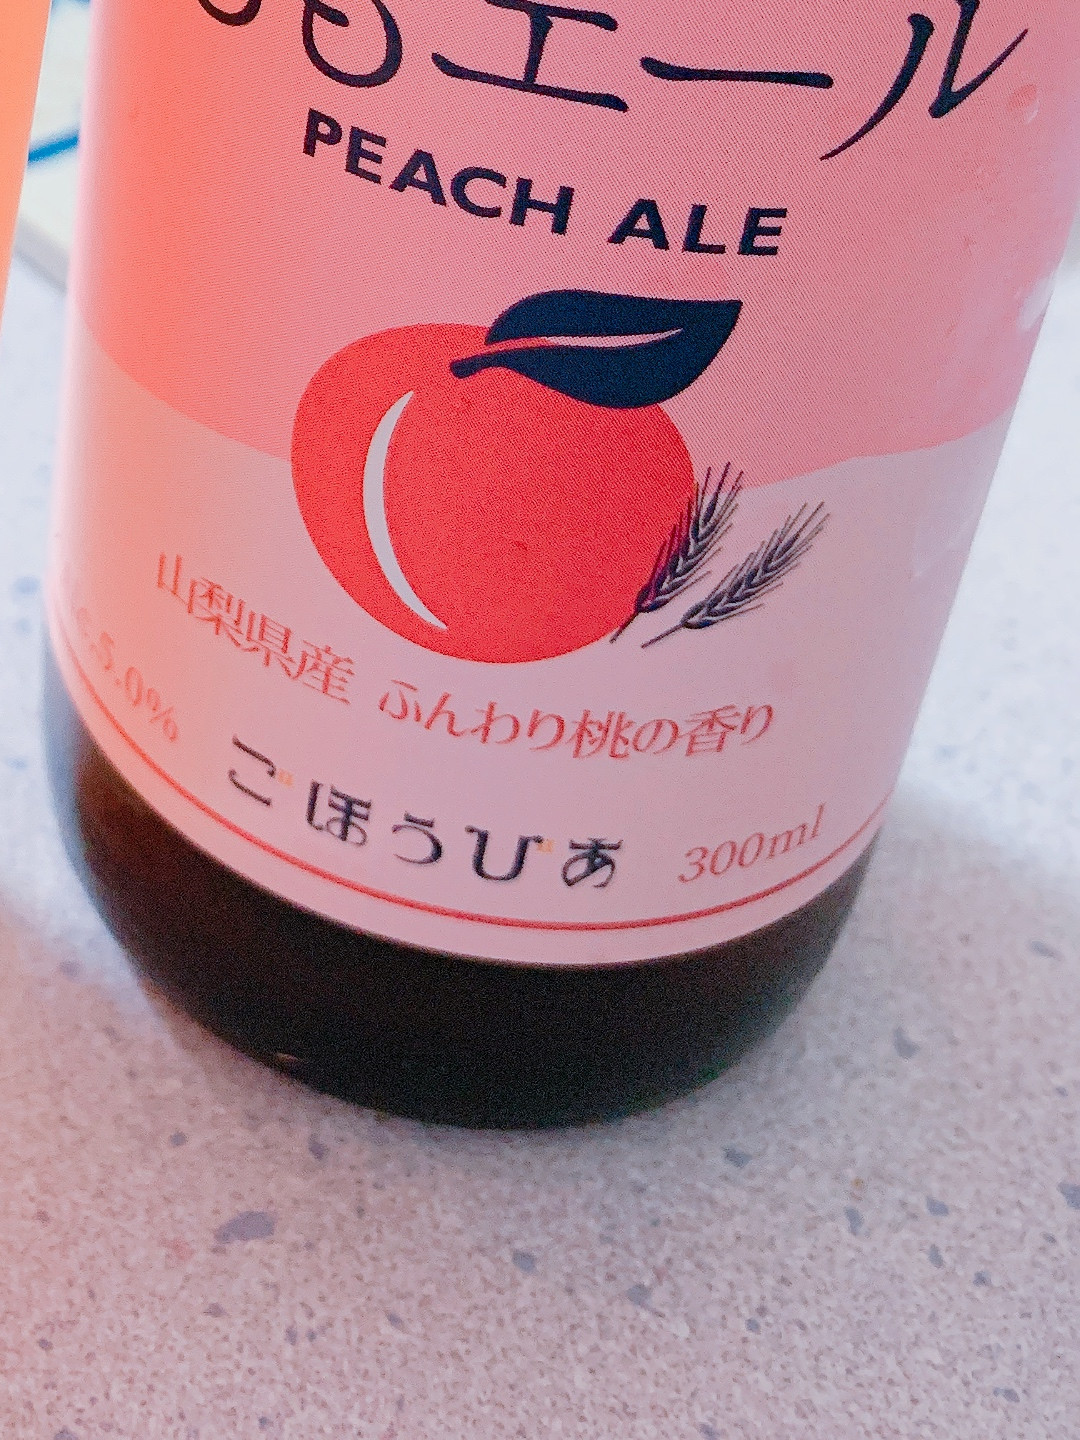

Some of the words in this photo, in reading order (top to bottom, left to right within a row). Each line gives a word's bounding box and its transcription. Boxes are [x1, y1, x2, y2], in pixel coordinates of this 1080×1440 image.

[302, 107, 575, 237] PEACH
[607, 197, 789, 258] ALE
[156, 551, 357, 706] 山梨県産
[377, 679, 776, 761] ふんわり桃の香り
[676, 800, 826, 885] 300ml
